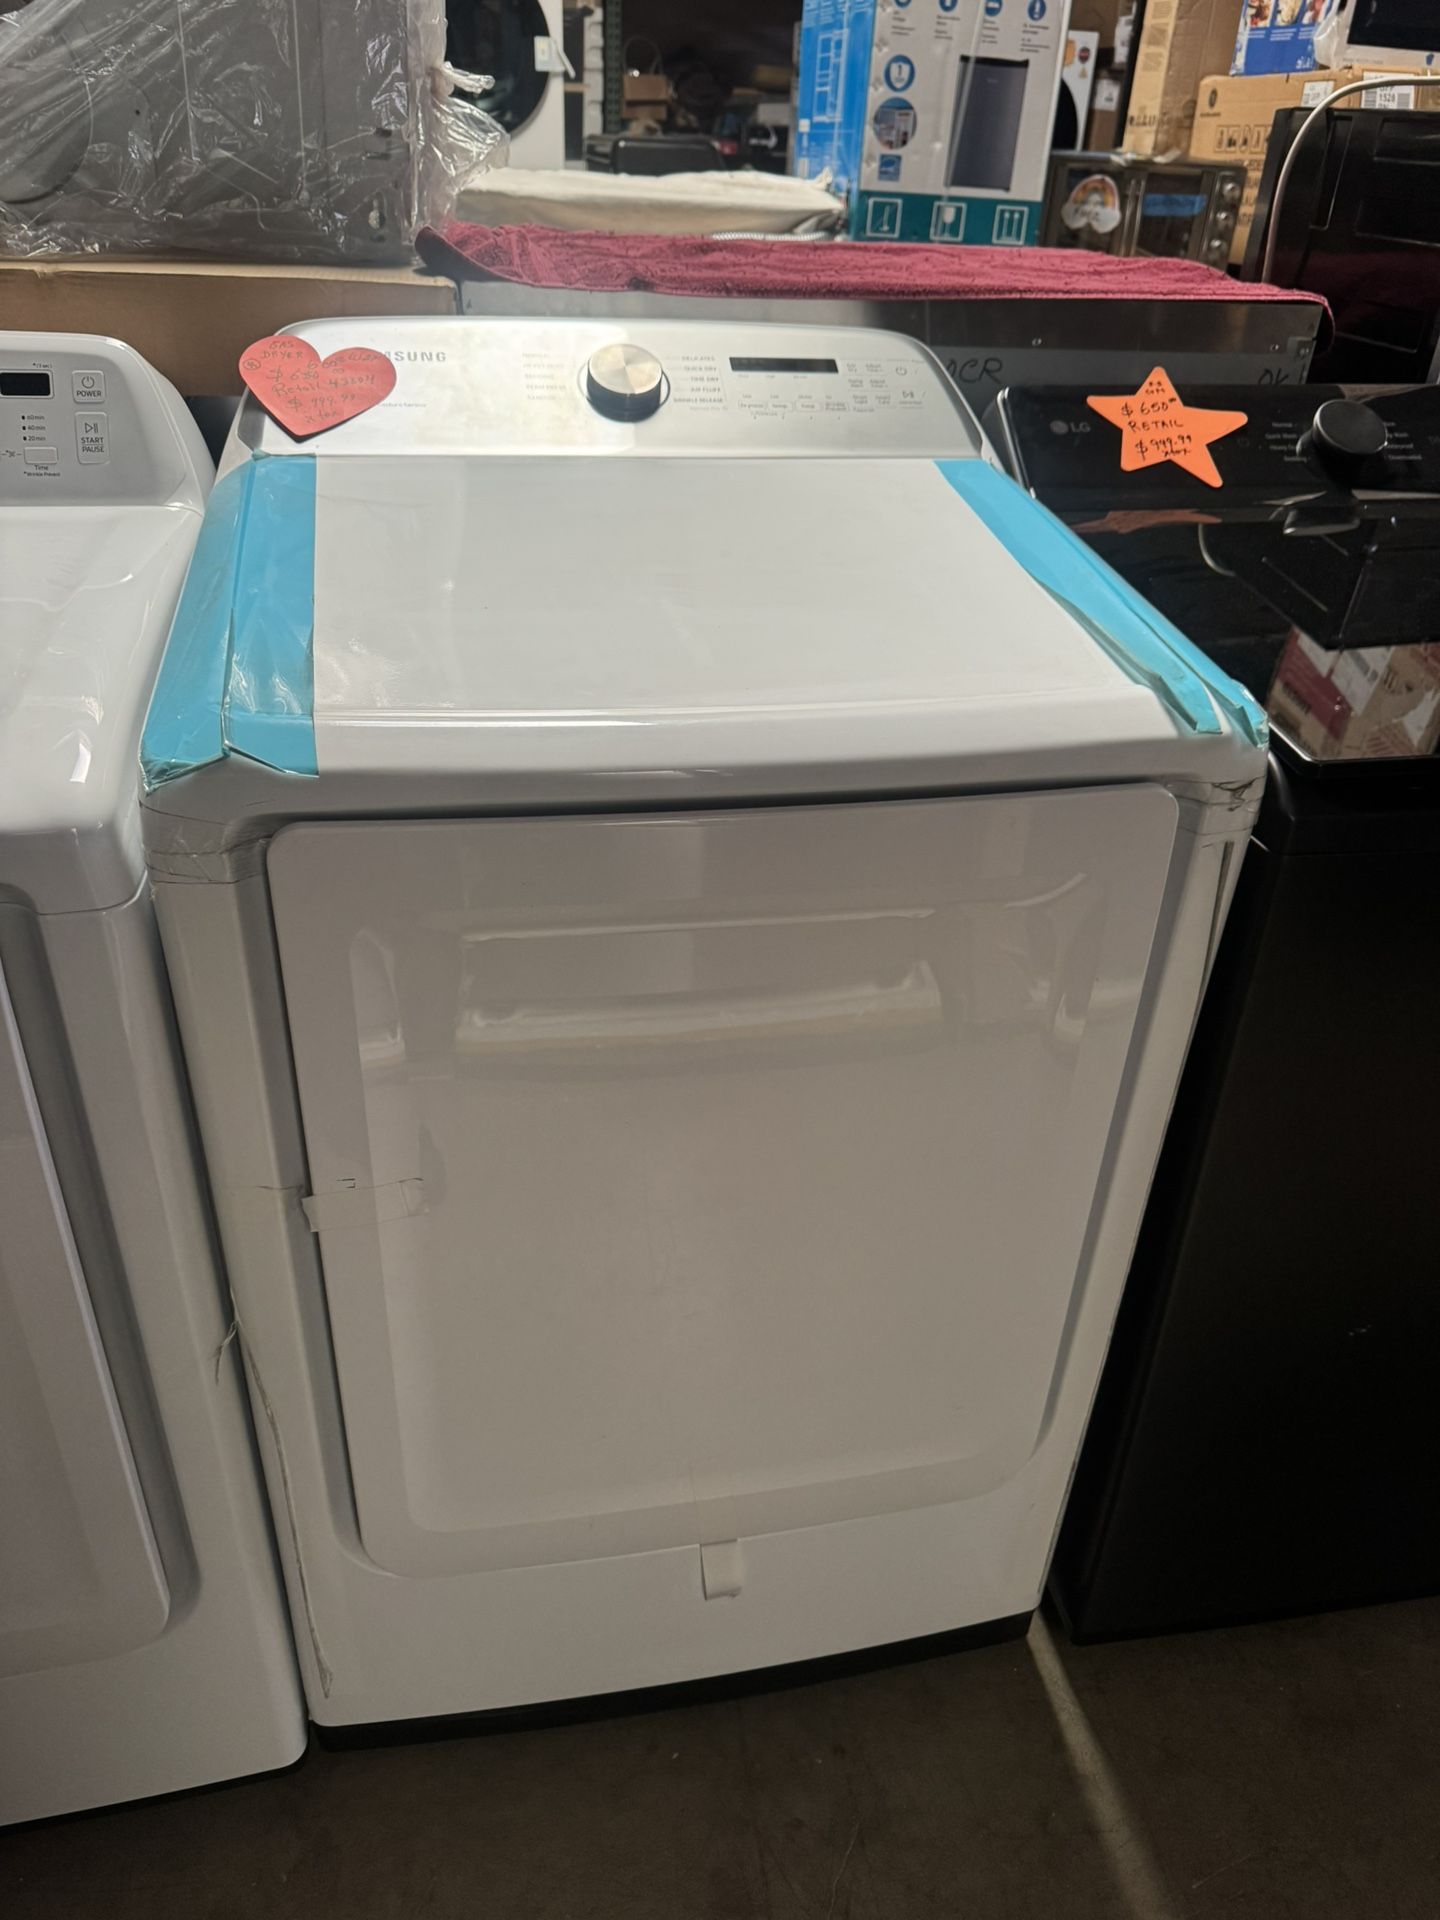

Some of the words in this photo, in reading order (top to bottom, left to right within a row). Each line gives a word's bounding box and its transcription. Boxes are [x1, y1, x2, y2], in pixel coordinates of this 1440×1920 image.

[385, 350, 448, 362] SUNG
[1127, 418, 1184, 433] RETAIL
[81, 436, 104, 444] START
